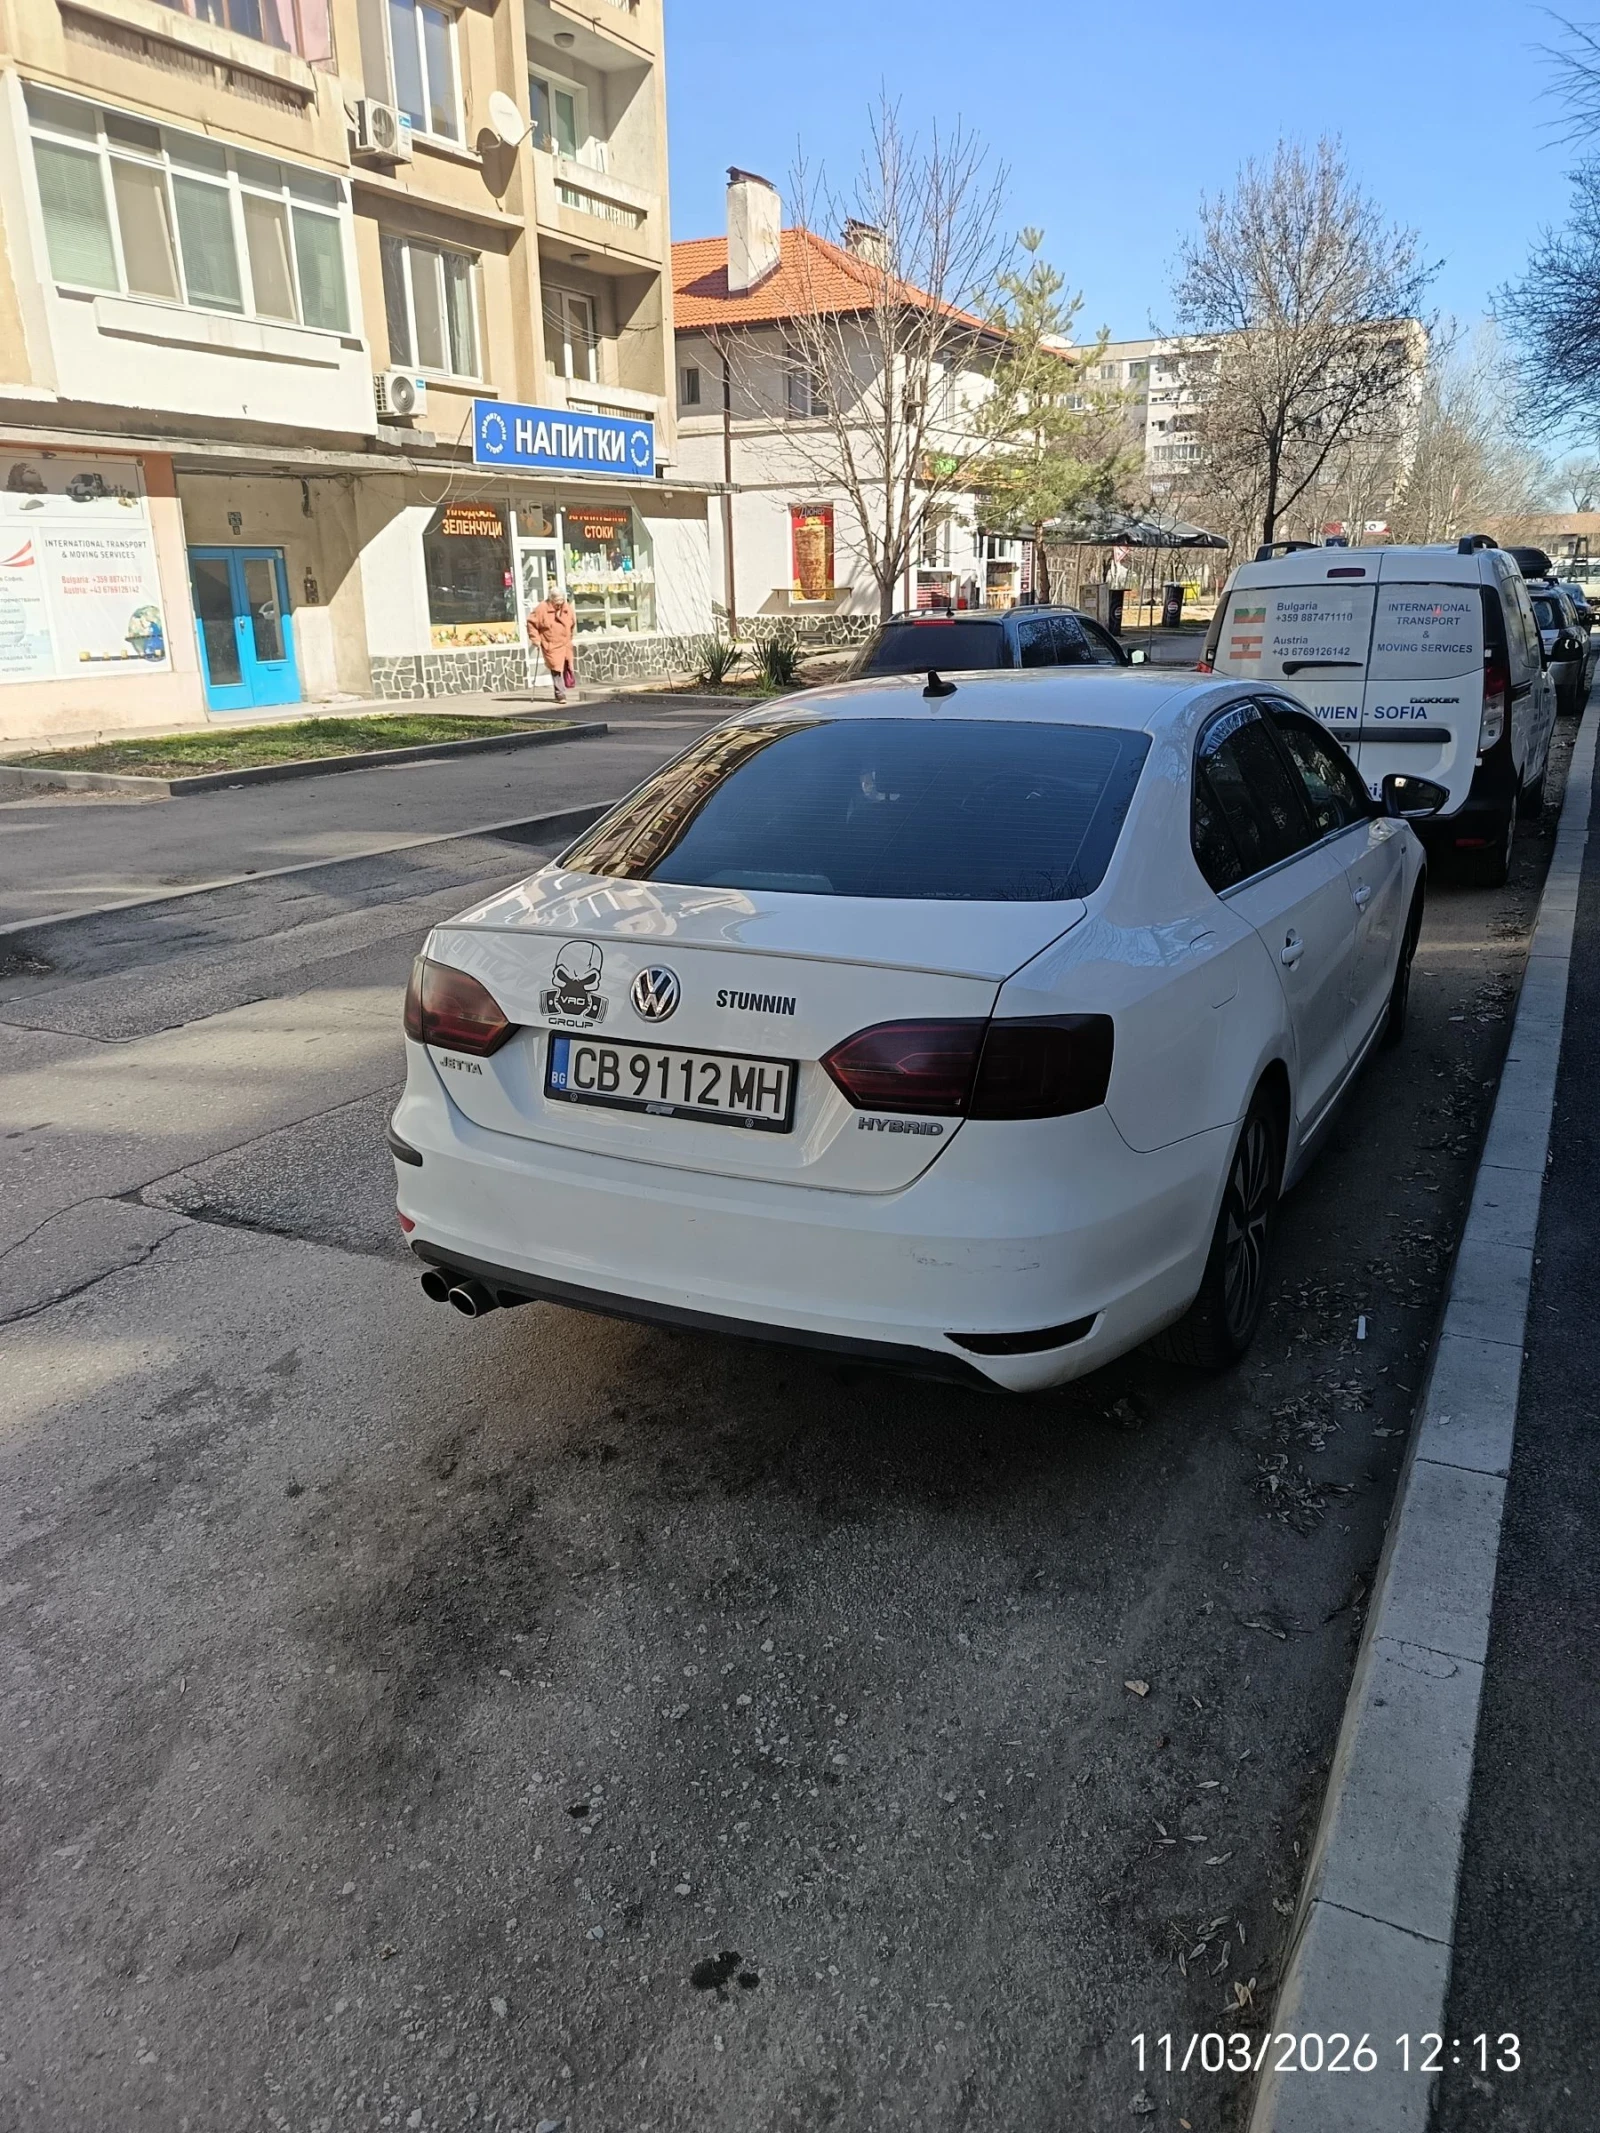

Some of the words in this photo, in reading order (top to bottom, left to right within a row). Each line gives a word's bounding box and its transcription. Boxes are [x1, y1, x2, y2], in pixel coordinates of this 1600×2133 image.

[515, 418, 626, 463] НАПИТКИ
[442, 518, 503, 539] ЗЕЛЕНЧУЦИ
[584, 525, 614, 539] СТОКИ
[45, 540, 105, 548] INTERNATIONAL
[107, 540, 147, 549] TRANSPORT
[69, 551, 99, 559] MOVING
[100, 551, 136, 559] SERVICES
[1276, 601, 1318, 613] Bulgaria
[1388, 603, 1472, 613] INTERNATIONAL
[1275, 613, 1299, 622] +359
[1300, 612, 1353, 622] 887471110
[1396, 616, 1461, 626] TRANSPORT
[1273, 636, 1309, 645] Austria
[1422, 630, 1430, 639] &
[1272, 647, 1289, 656] +43
[1291, 647, 1351, 656] 6769126142
[1376, 643, 1418, 652] MOVING
[1420, 644, 1473, 653] SERVICES
[1314, 706, 1359, 719] WIEN
[1374, 706, 1428, 720] SOFIA
[716, 988, 797, 1016] STUNNIN
[548, 1017, 594, 1029] GROUP
[440, 1056, 483, 1076] JETTA
[551, 1071, 566, 1086] BG
[857, 1116, 944, 1137] HYBRID
